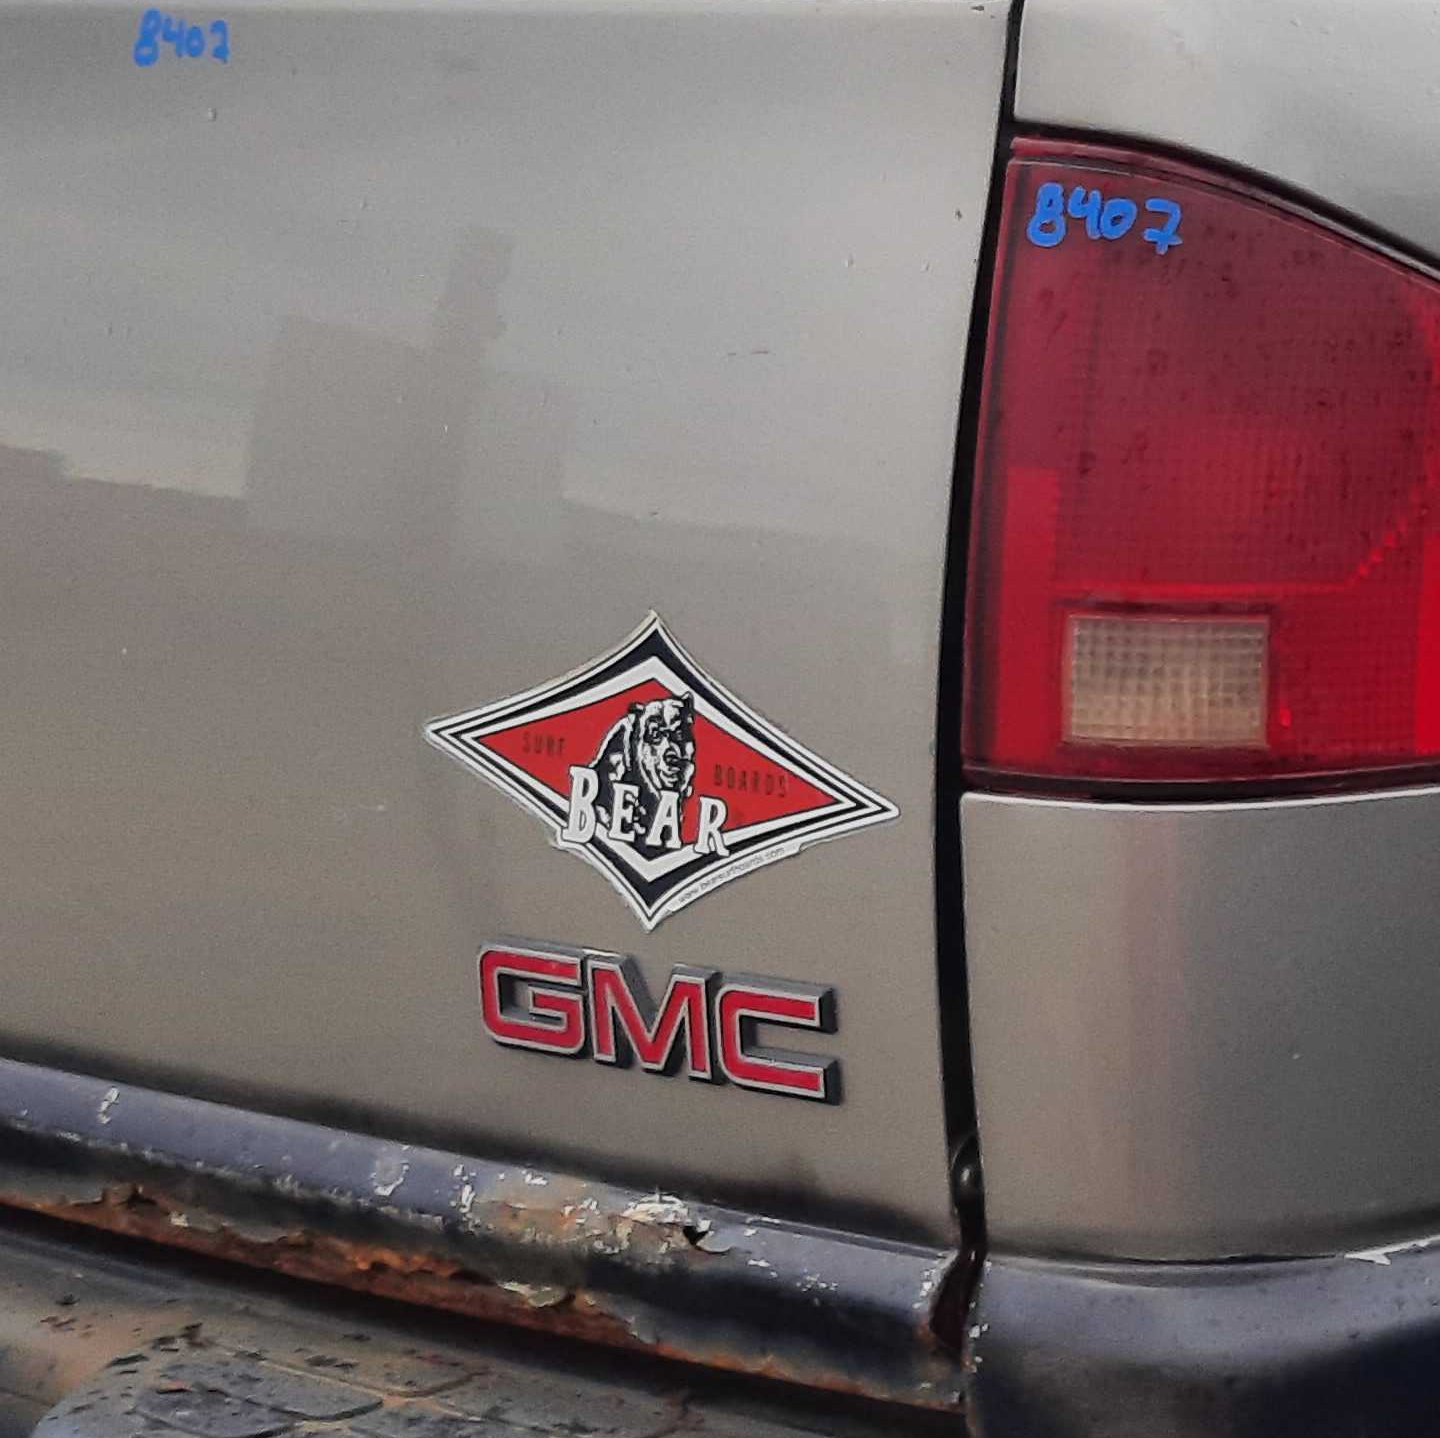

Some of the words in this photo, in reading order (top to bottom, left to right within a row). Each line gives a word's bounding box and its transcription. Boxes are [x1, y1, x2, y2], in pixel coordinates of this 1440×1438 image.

[1026, 181, 1183, 255] 8407
[563, 766, 730, 857] BEAR
[477, 945, 840, 1103] GMC
